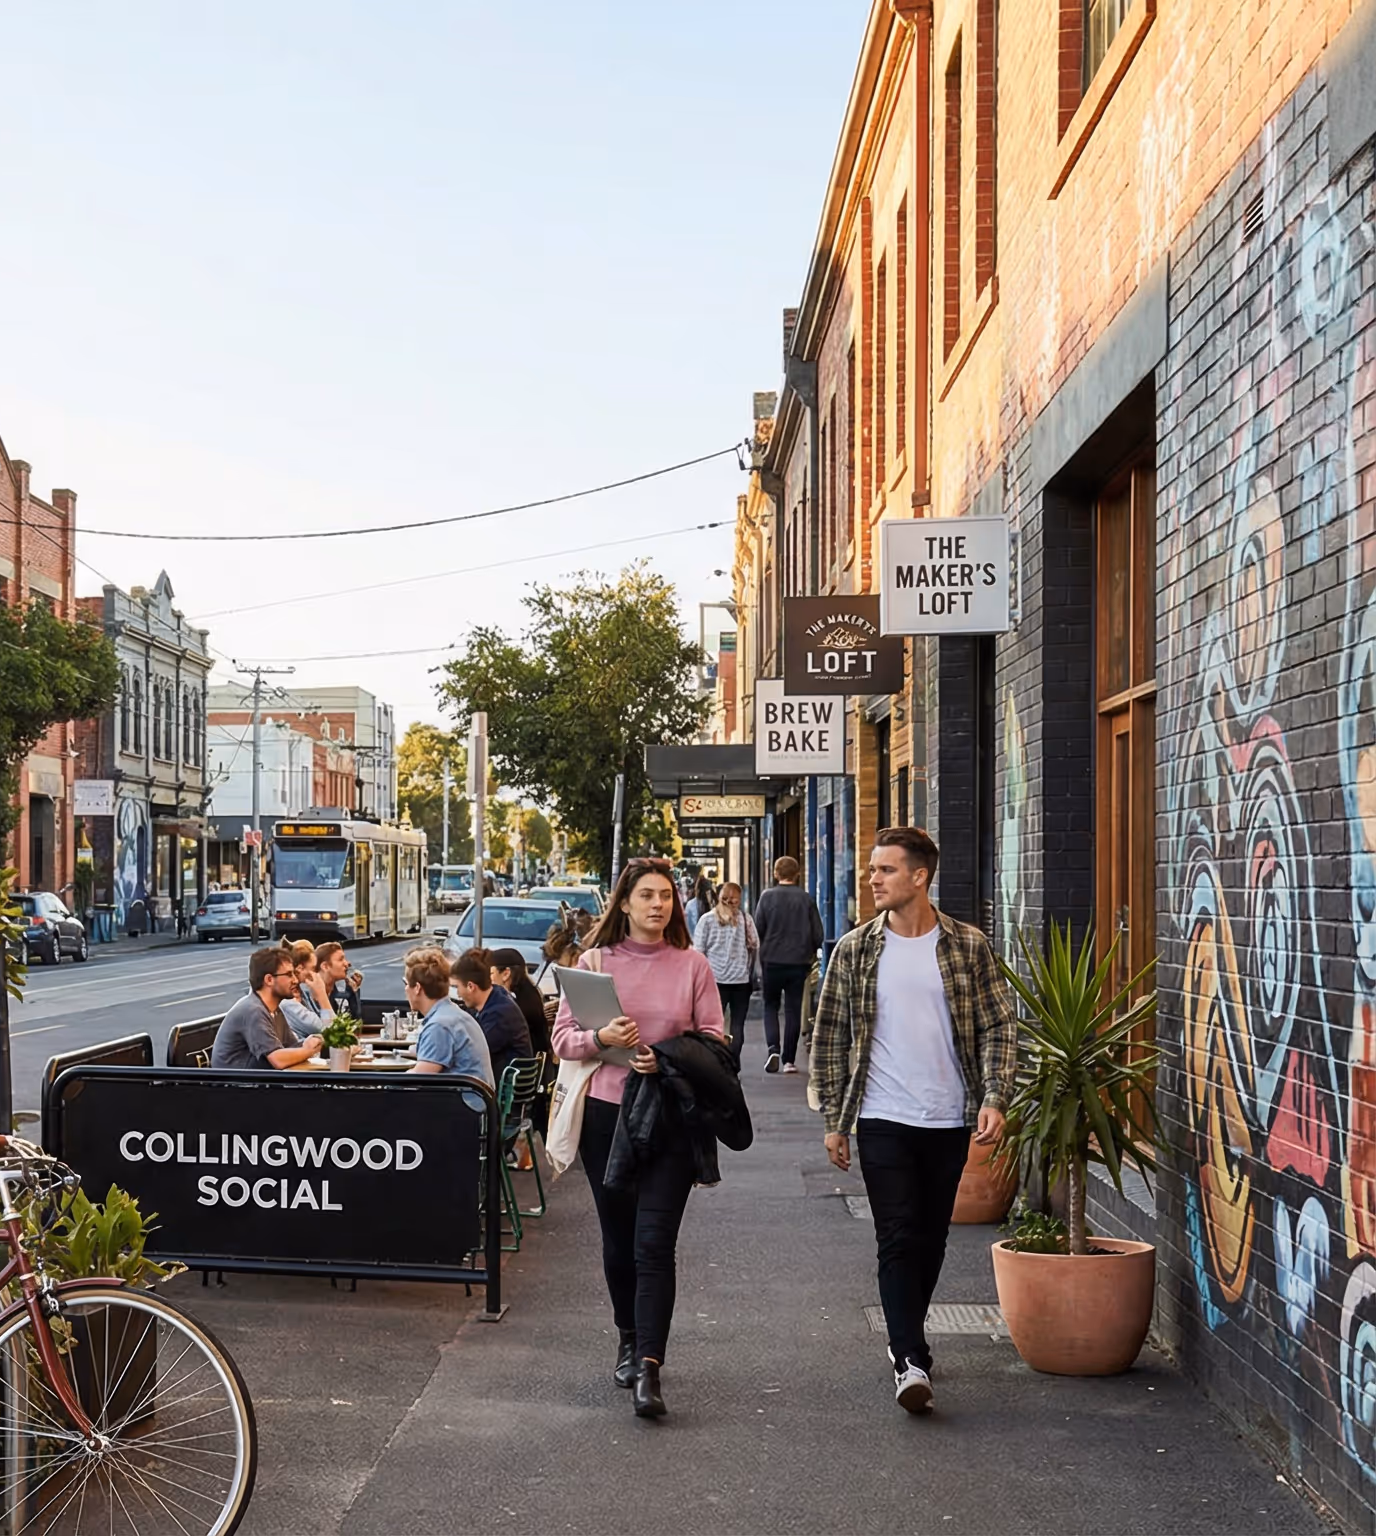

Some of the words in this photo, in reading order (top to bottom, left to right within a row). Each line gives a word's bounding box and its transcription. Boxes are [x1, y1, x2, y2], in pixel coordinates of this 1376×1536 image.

[924, 536, 966, 559] THE
[896, 563, 996, 588] MAKER'S
[919, 592, 973, 615] LOFT
[807, 651, 877, 673] LOFT
[765, 702, 833, 724] BREW
[768, 730, 829, 752] BAKE
[119, 1131, 423, 1170] COLLINGWOOD
[197, 1175, 343, 1211] SOCIAL
